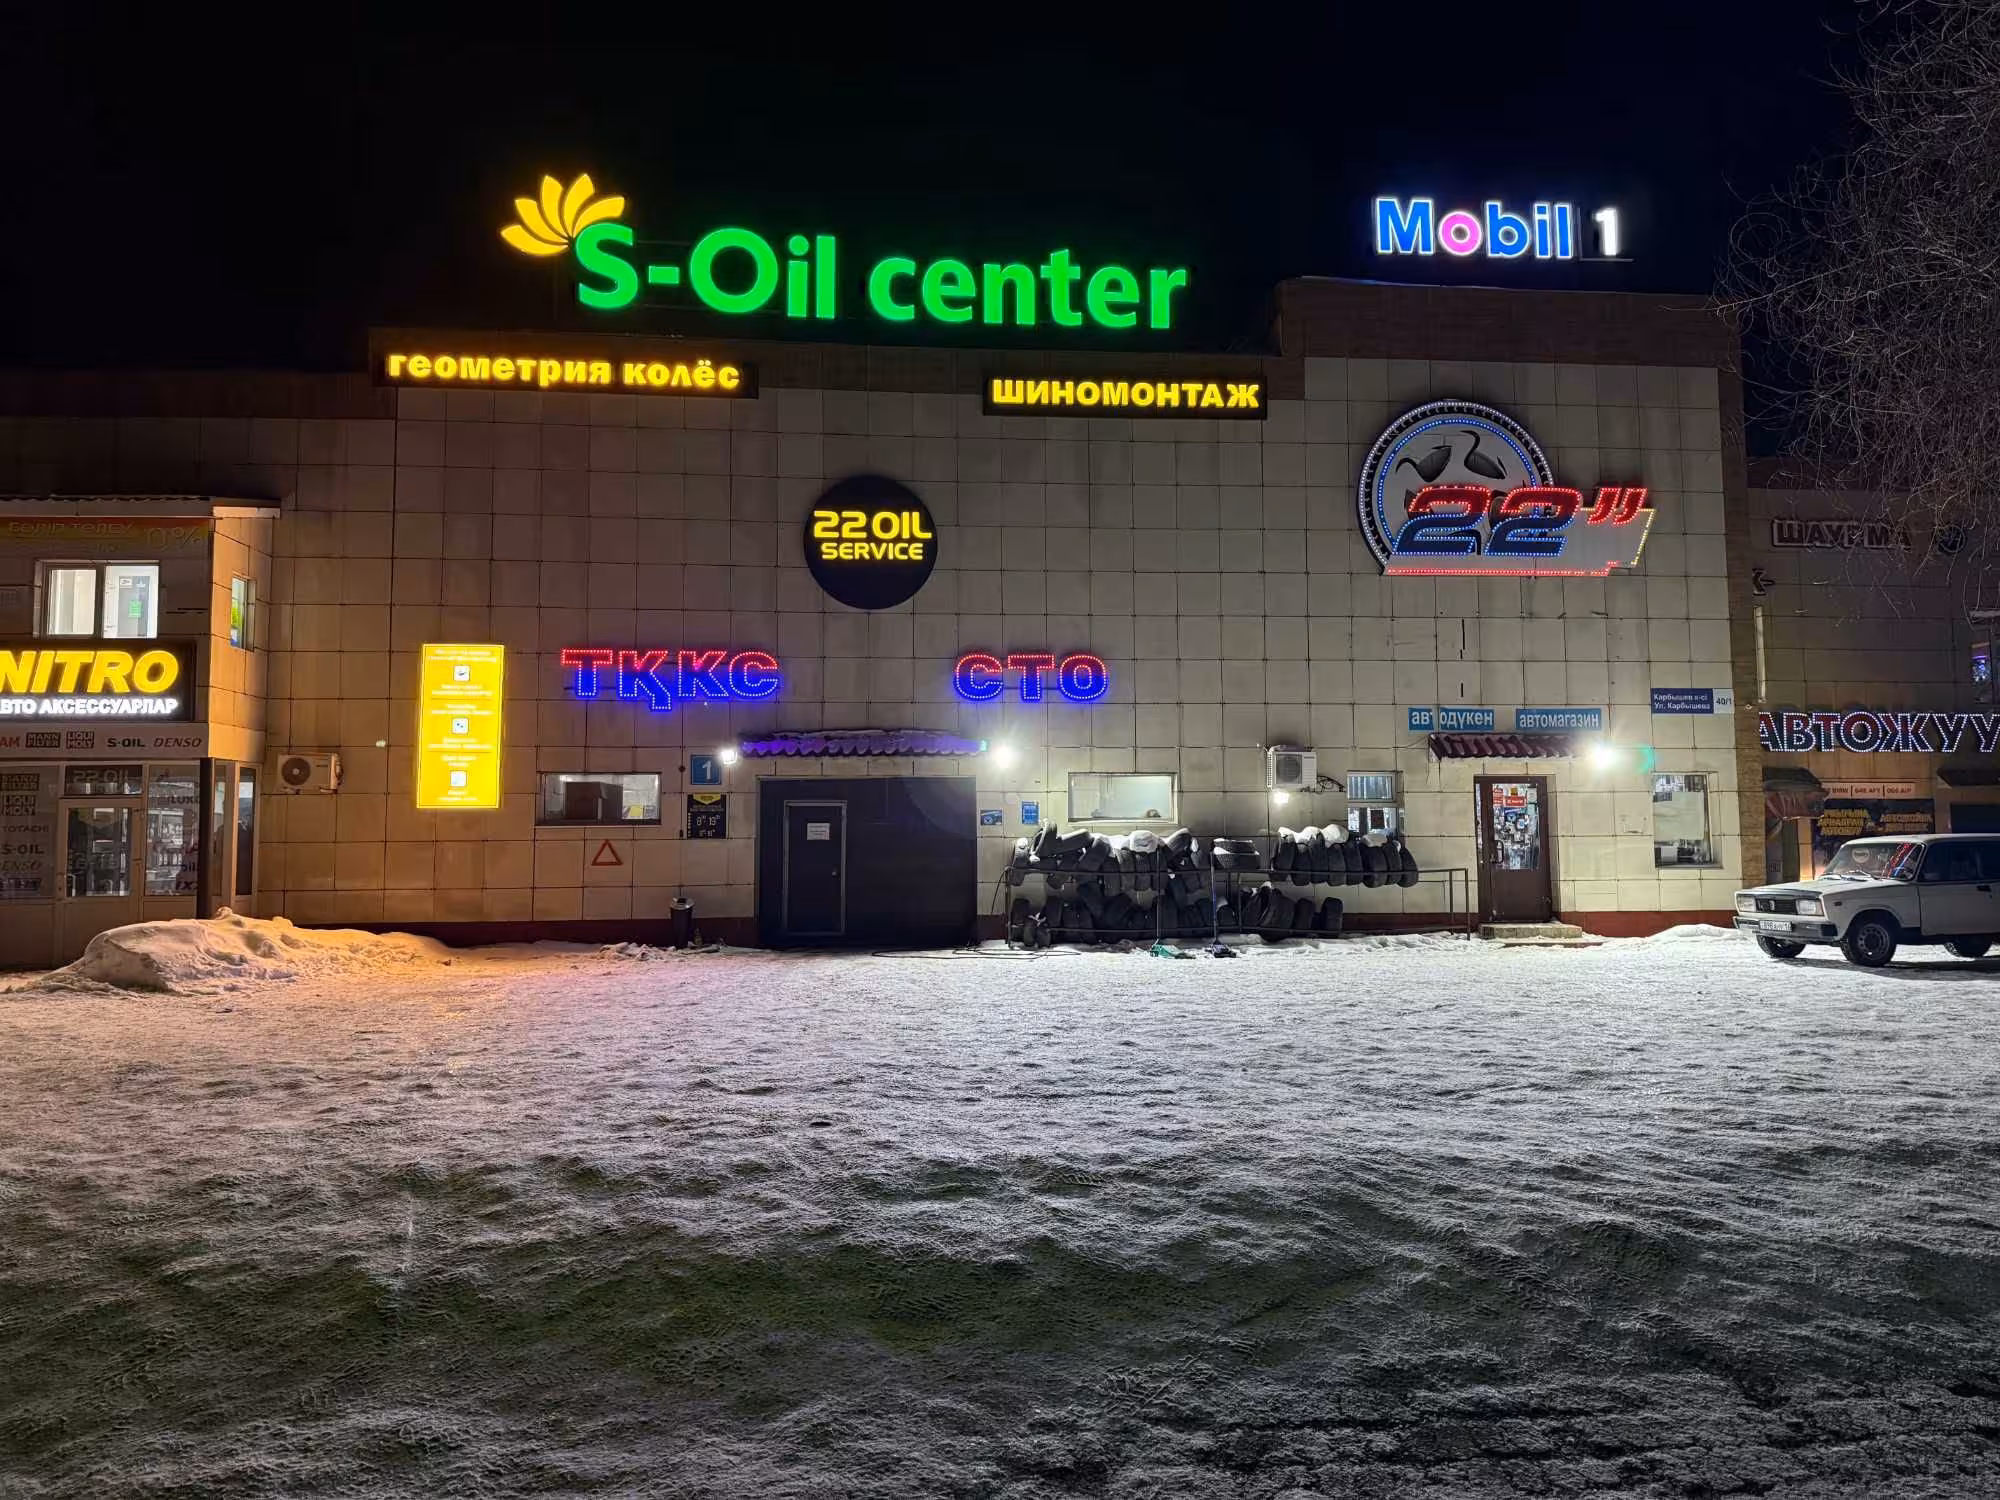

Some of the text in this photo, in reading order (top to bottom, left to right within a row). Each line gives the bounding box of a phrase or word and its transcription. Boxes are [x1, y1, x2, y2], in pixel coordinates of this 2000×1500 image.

[1376, 197, 1617, 259] Mobil 1
[574, 222, 1188, 330] S-Oil center
[387, 352, 741, 390] геометрия колёс
[991, 378, 1260, 409] ШИНОМОНТАЖ
[813, 510, 932, 540] 22 OIL
[821, 542, 924, 561] SERVICE
[0, 650, 179, 694] NITRO
[561, 648, 780, 711] ТҚКС
[953, 652, 1109, 701] СТО
[0, 698, 179, 715] ВТО АКСЕССУАРЛАР
[1519, 713, 1600, 729] автомагазин
[153, 737, 202, 748] DENSO
[702, 761, 712, 780] 1
